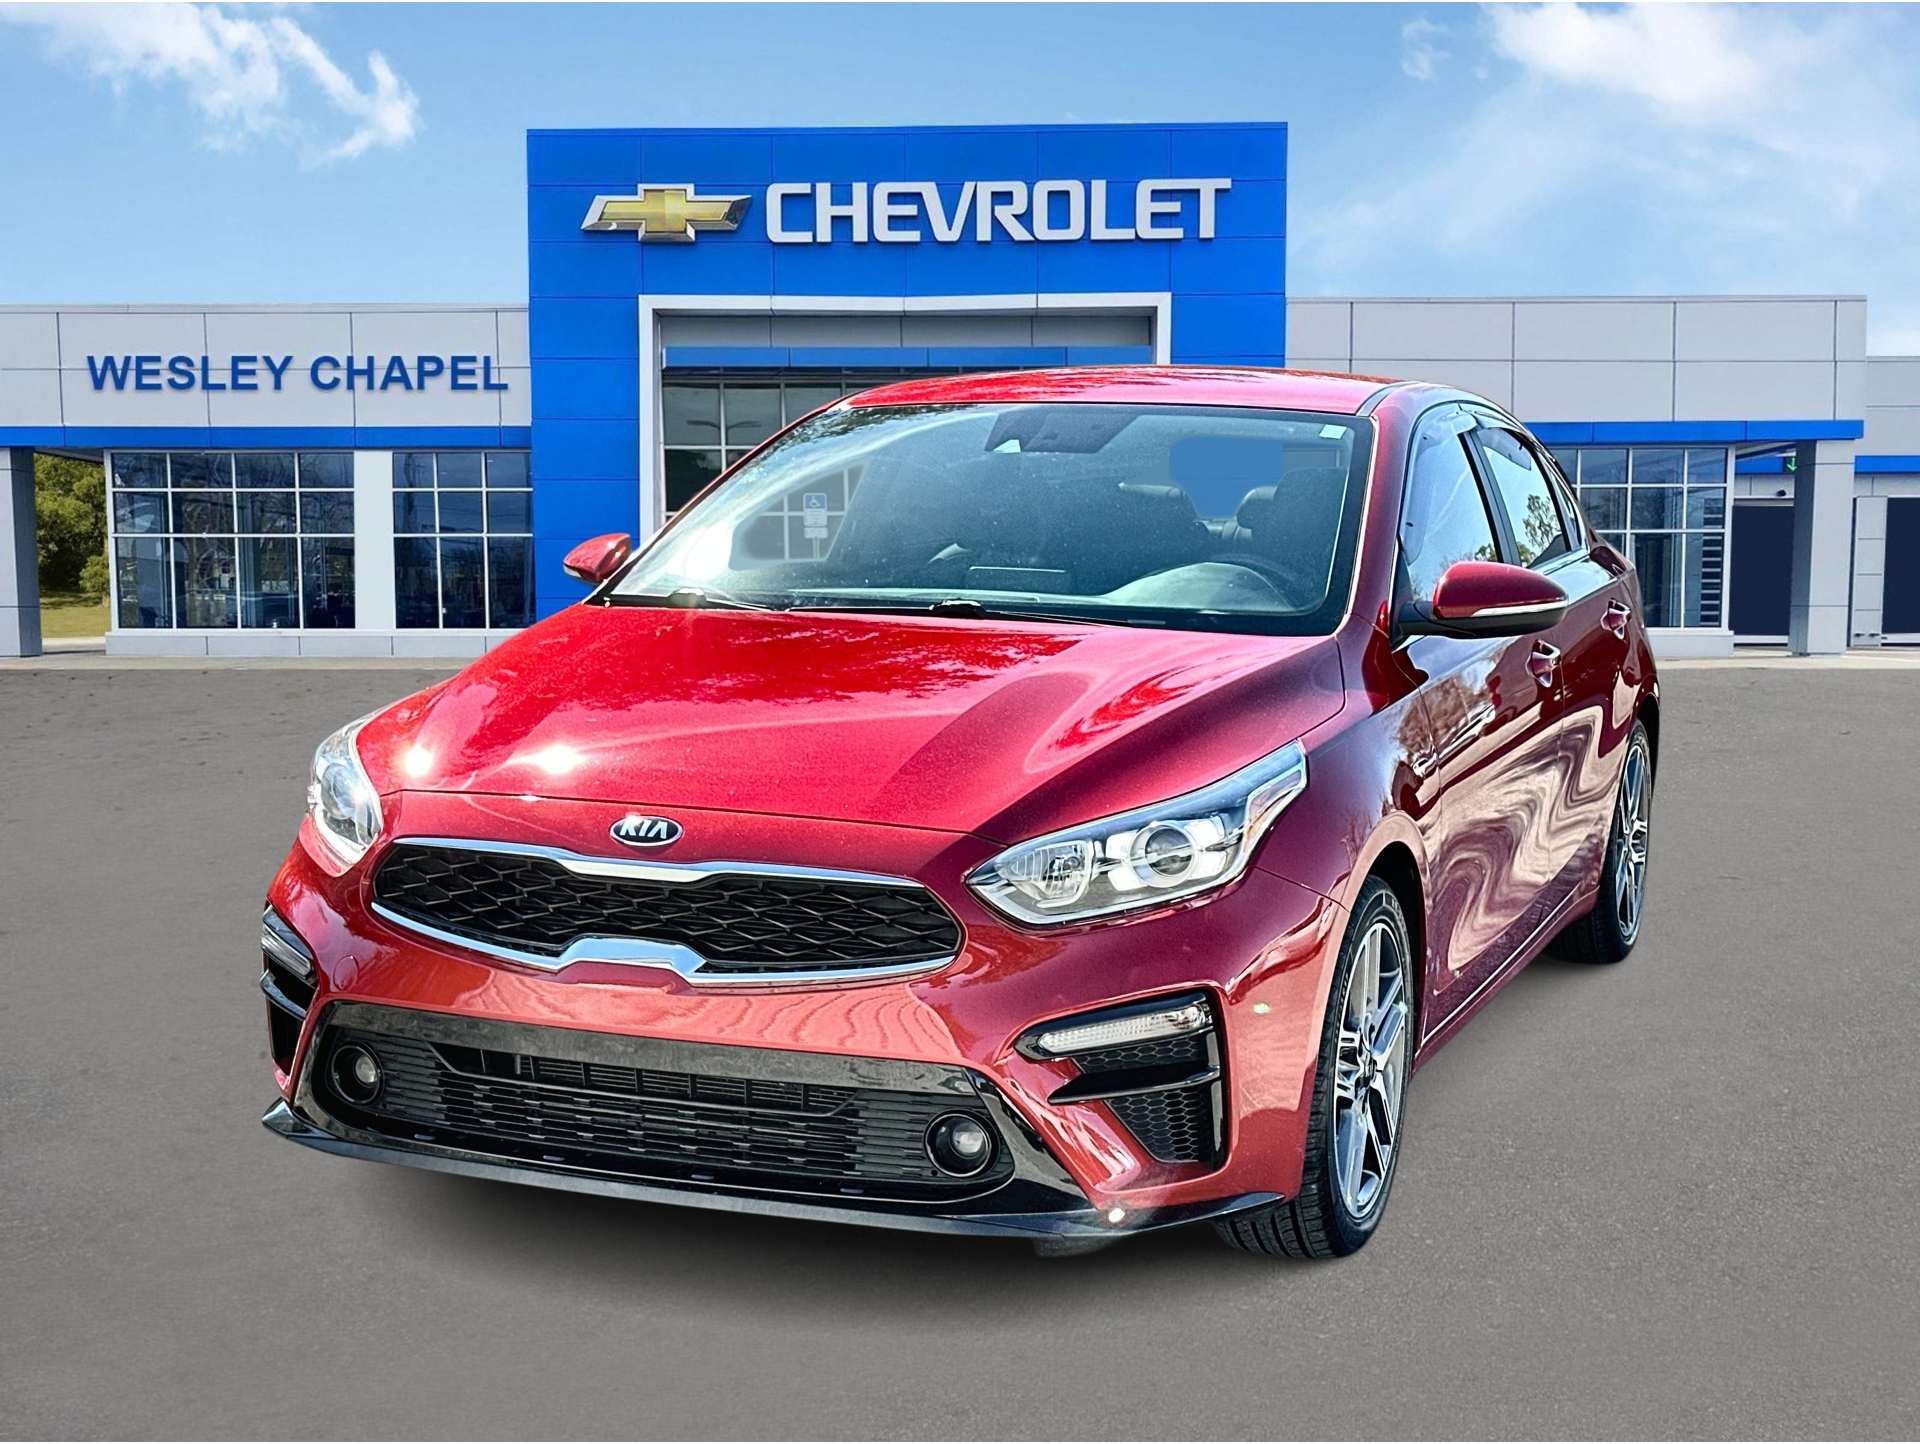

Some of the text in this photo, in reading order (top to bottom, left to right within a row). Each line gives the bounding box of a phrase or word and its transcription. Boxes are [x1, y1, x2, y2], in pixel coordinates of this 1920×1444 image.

[766, 177, 1232, 243] CHEVROLET
[86, 355, 509, 391] WESLEY CHAPEL
[619, 819, 668, 839] KIA
